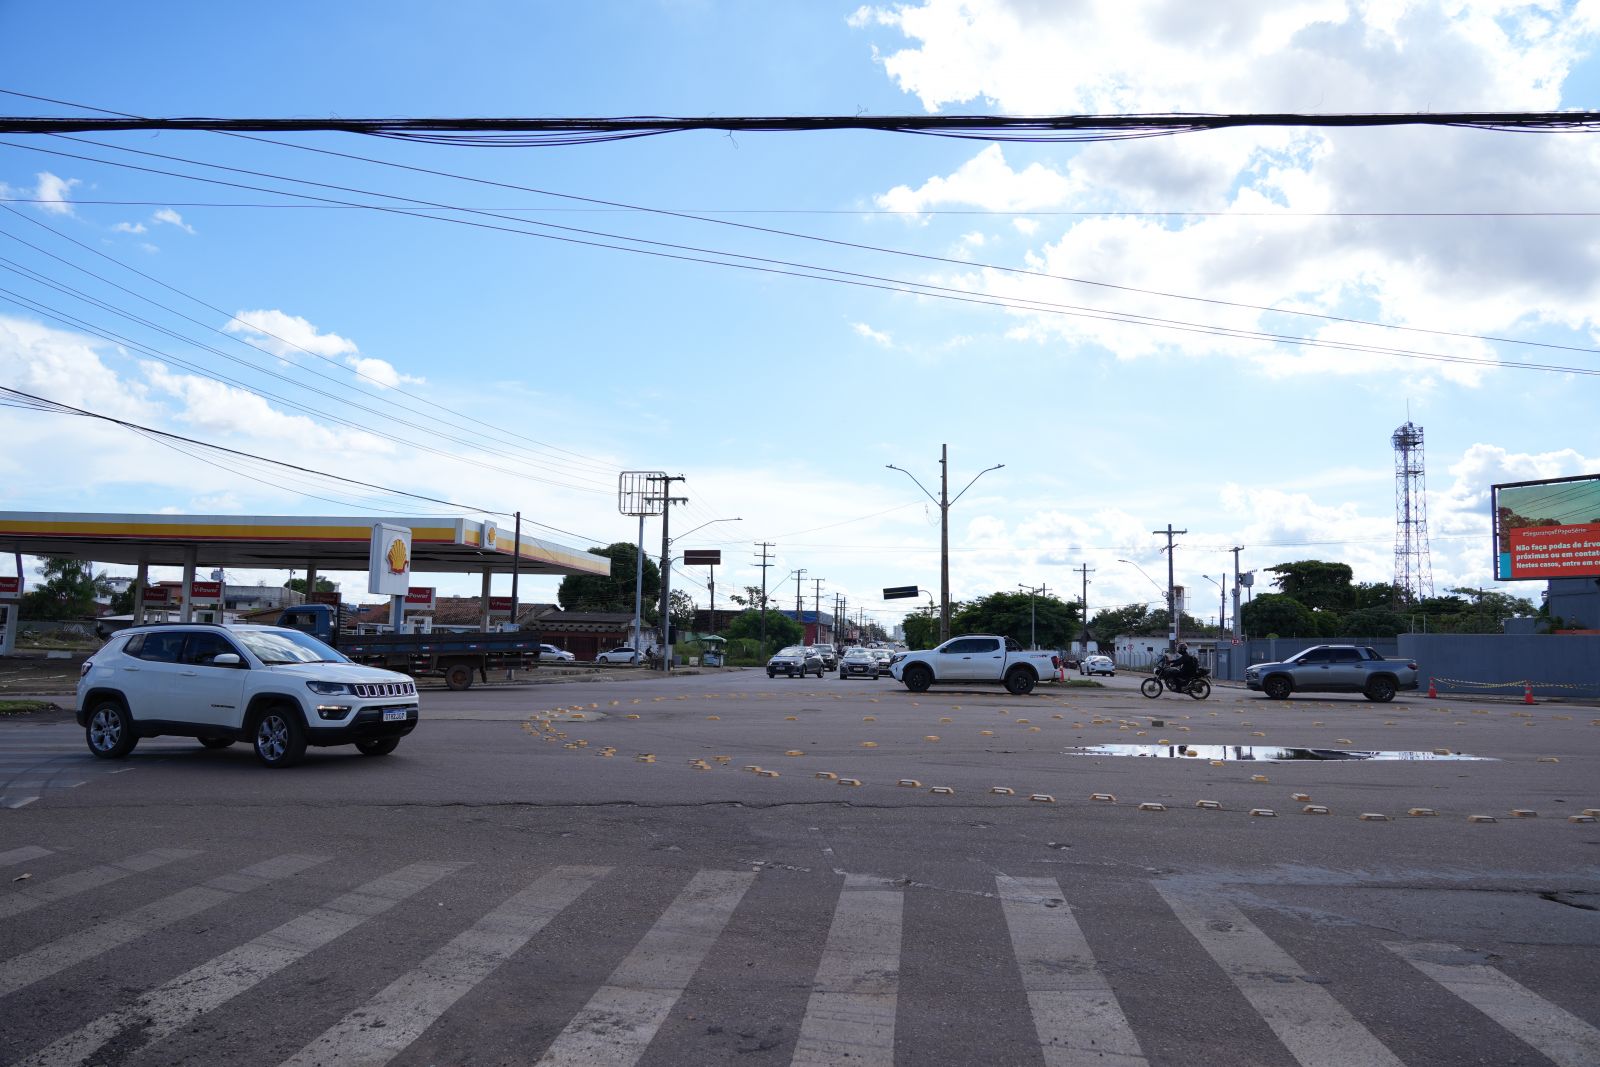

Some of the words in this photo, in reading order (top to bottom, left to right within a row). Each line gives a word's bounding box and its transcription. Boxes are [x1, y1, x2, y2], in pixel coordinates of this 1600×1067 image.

[1531, 543, 1547, 551] faça
[1548, 542, 1571, 551] podas
[1516, 553, 1549, 561] próximas
